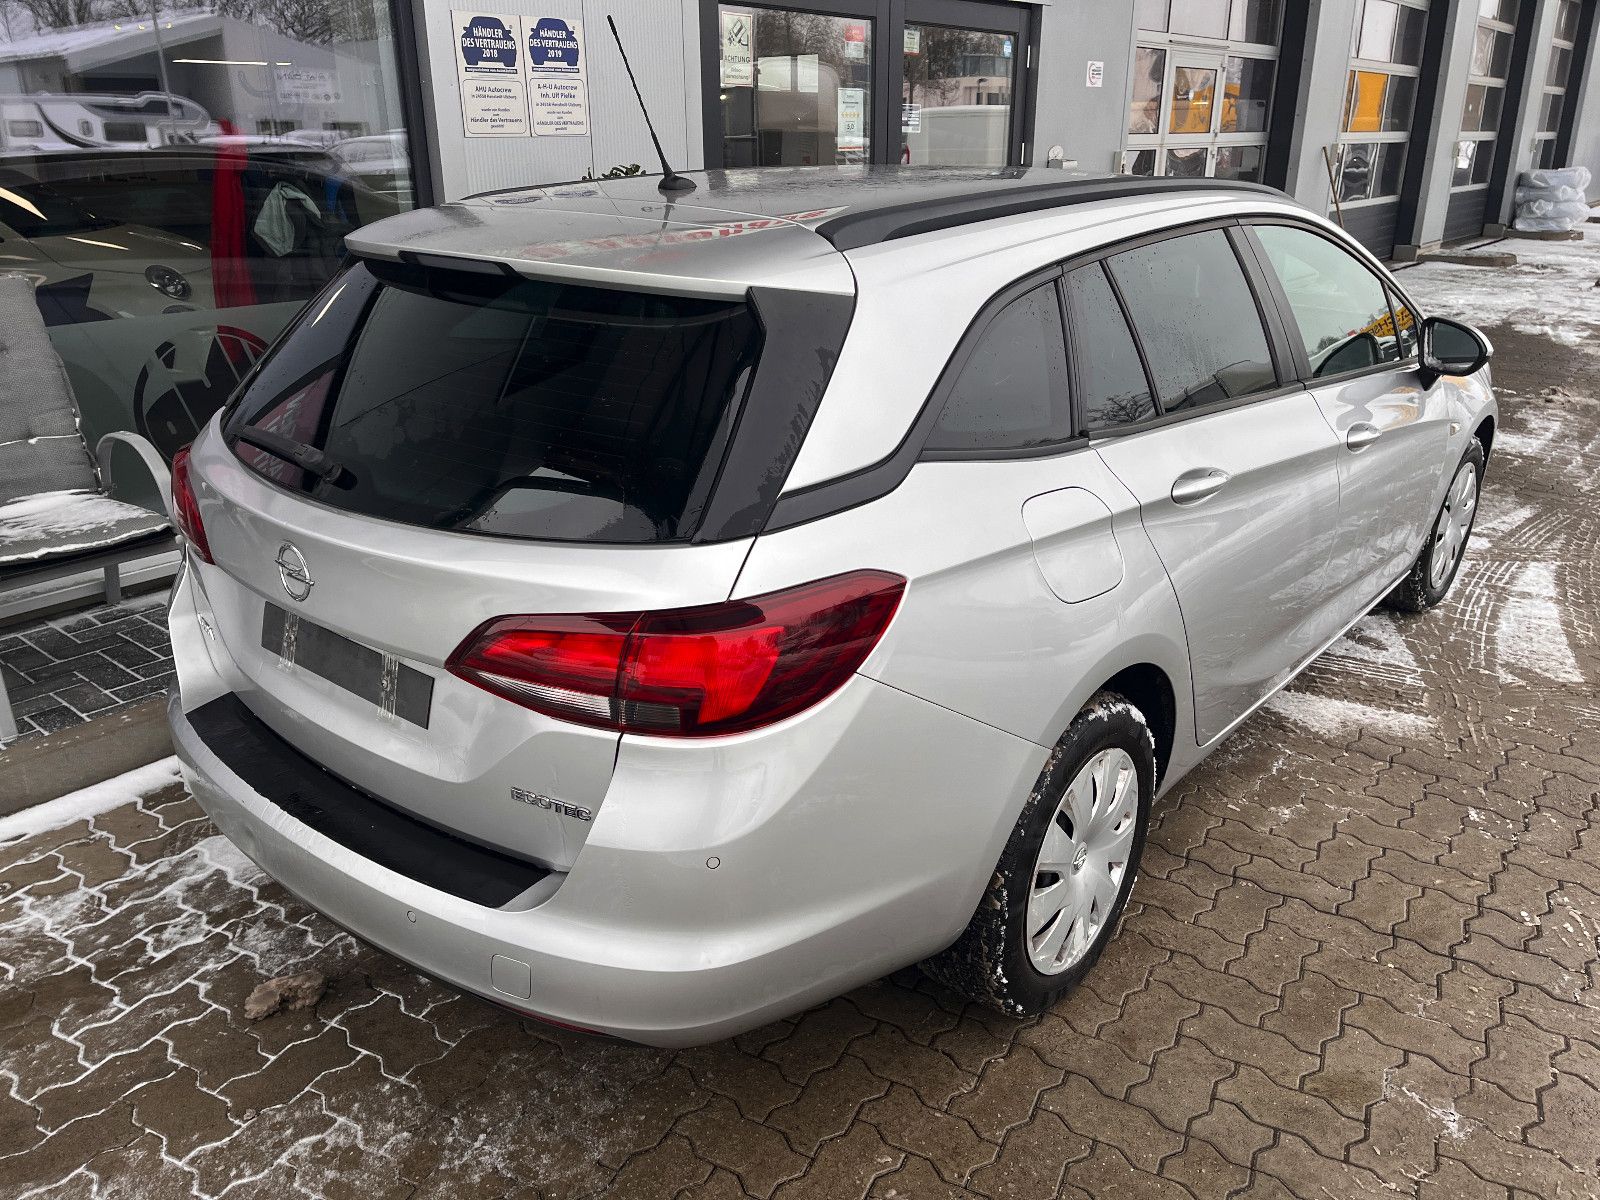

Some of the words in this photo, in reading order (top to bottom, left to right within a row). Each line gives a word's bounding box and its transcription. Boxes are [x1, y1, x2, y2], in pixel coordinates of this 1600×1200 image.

[473, 26, 503, 38] HÄNDLER
[540, 28, 566, 38] HÄNDLER
[462, 38, 475, 47] DES
[475, 38, 515, 49] VERTRAUENS
[541, 39, 577, 48] VERTRAUENS
[482, 49, 498, 57] 2018
[725, 55, 750, 63] ACHTUNG
[511, 786, 592, 821] ECOTEC
